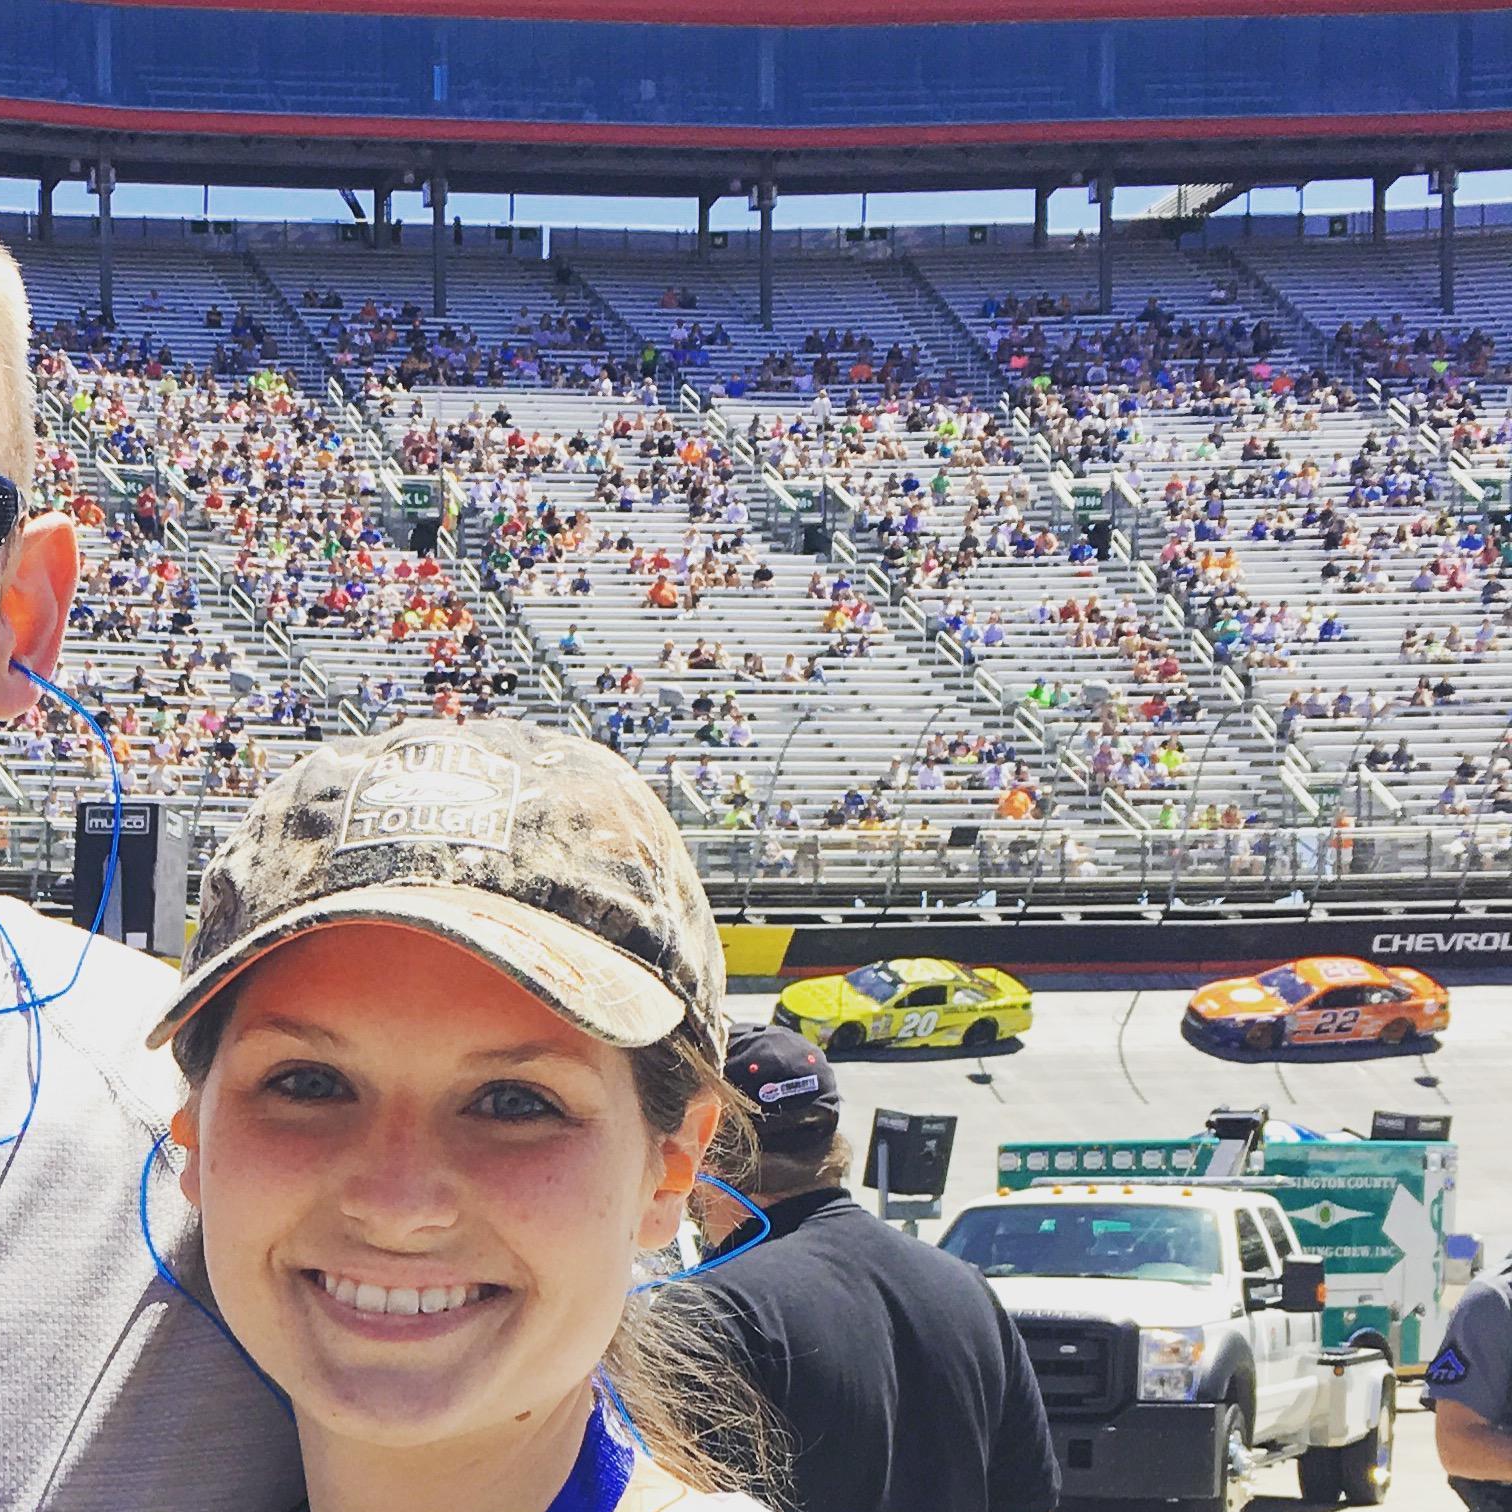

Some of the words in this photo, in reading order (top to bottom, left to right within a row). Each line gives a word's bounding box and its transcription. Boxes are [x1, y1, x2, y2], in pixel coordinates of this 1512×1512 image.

[369, 743, 510, 780] BUILT
[89, 817, 145, 829] muco
[352, 805, 498, 839] TOUGH
[1372, 932, 1512, 953] CHEVROL
[898, 1011, 939, 1038] 20
[1313, 1008, 1362, 1035] 22
